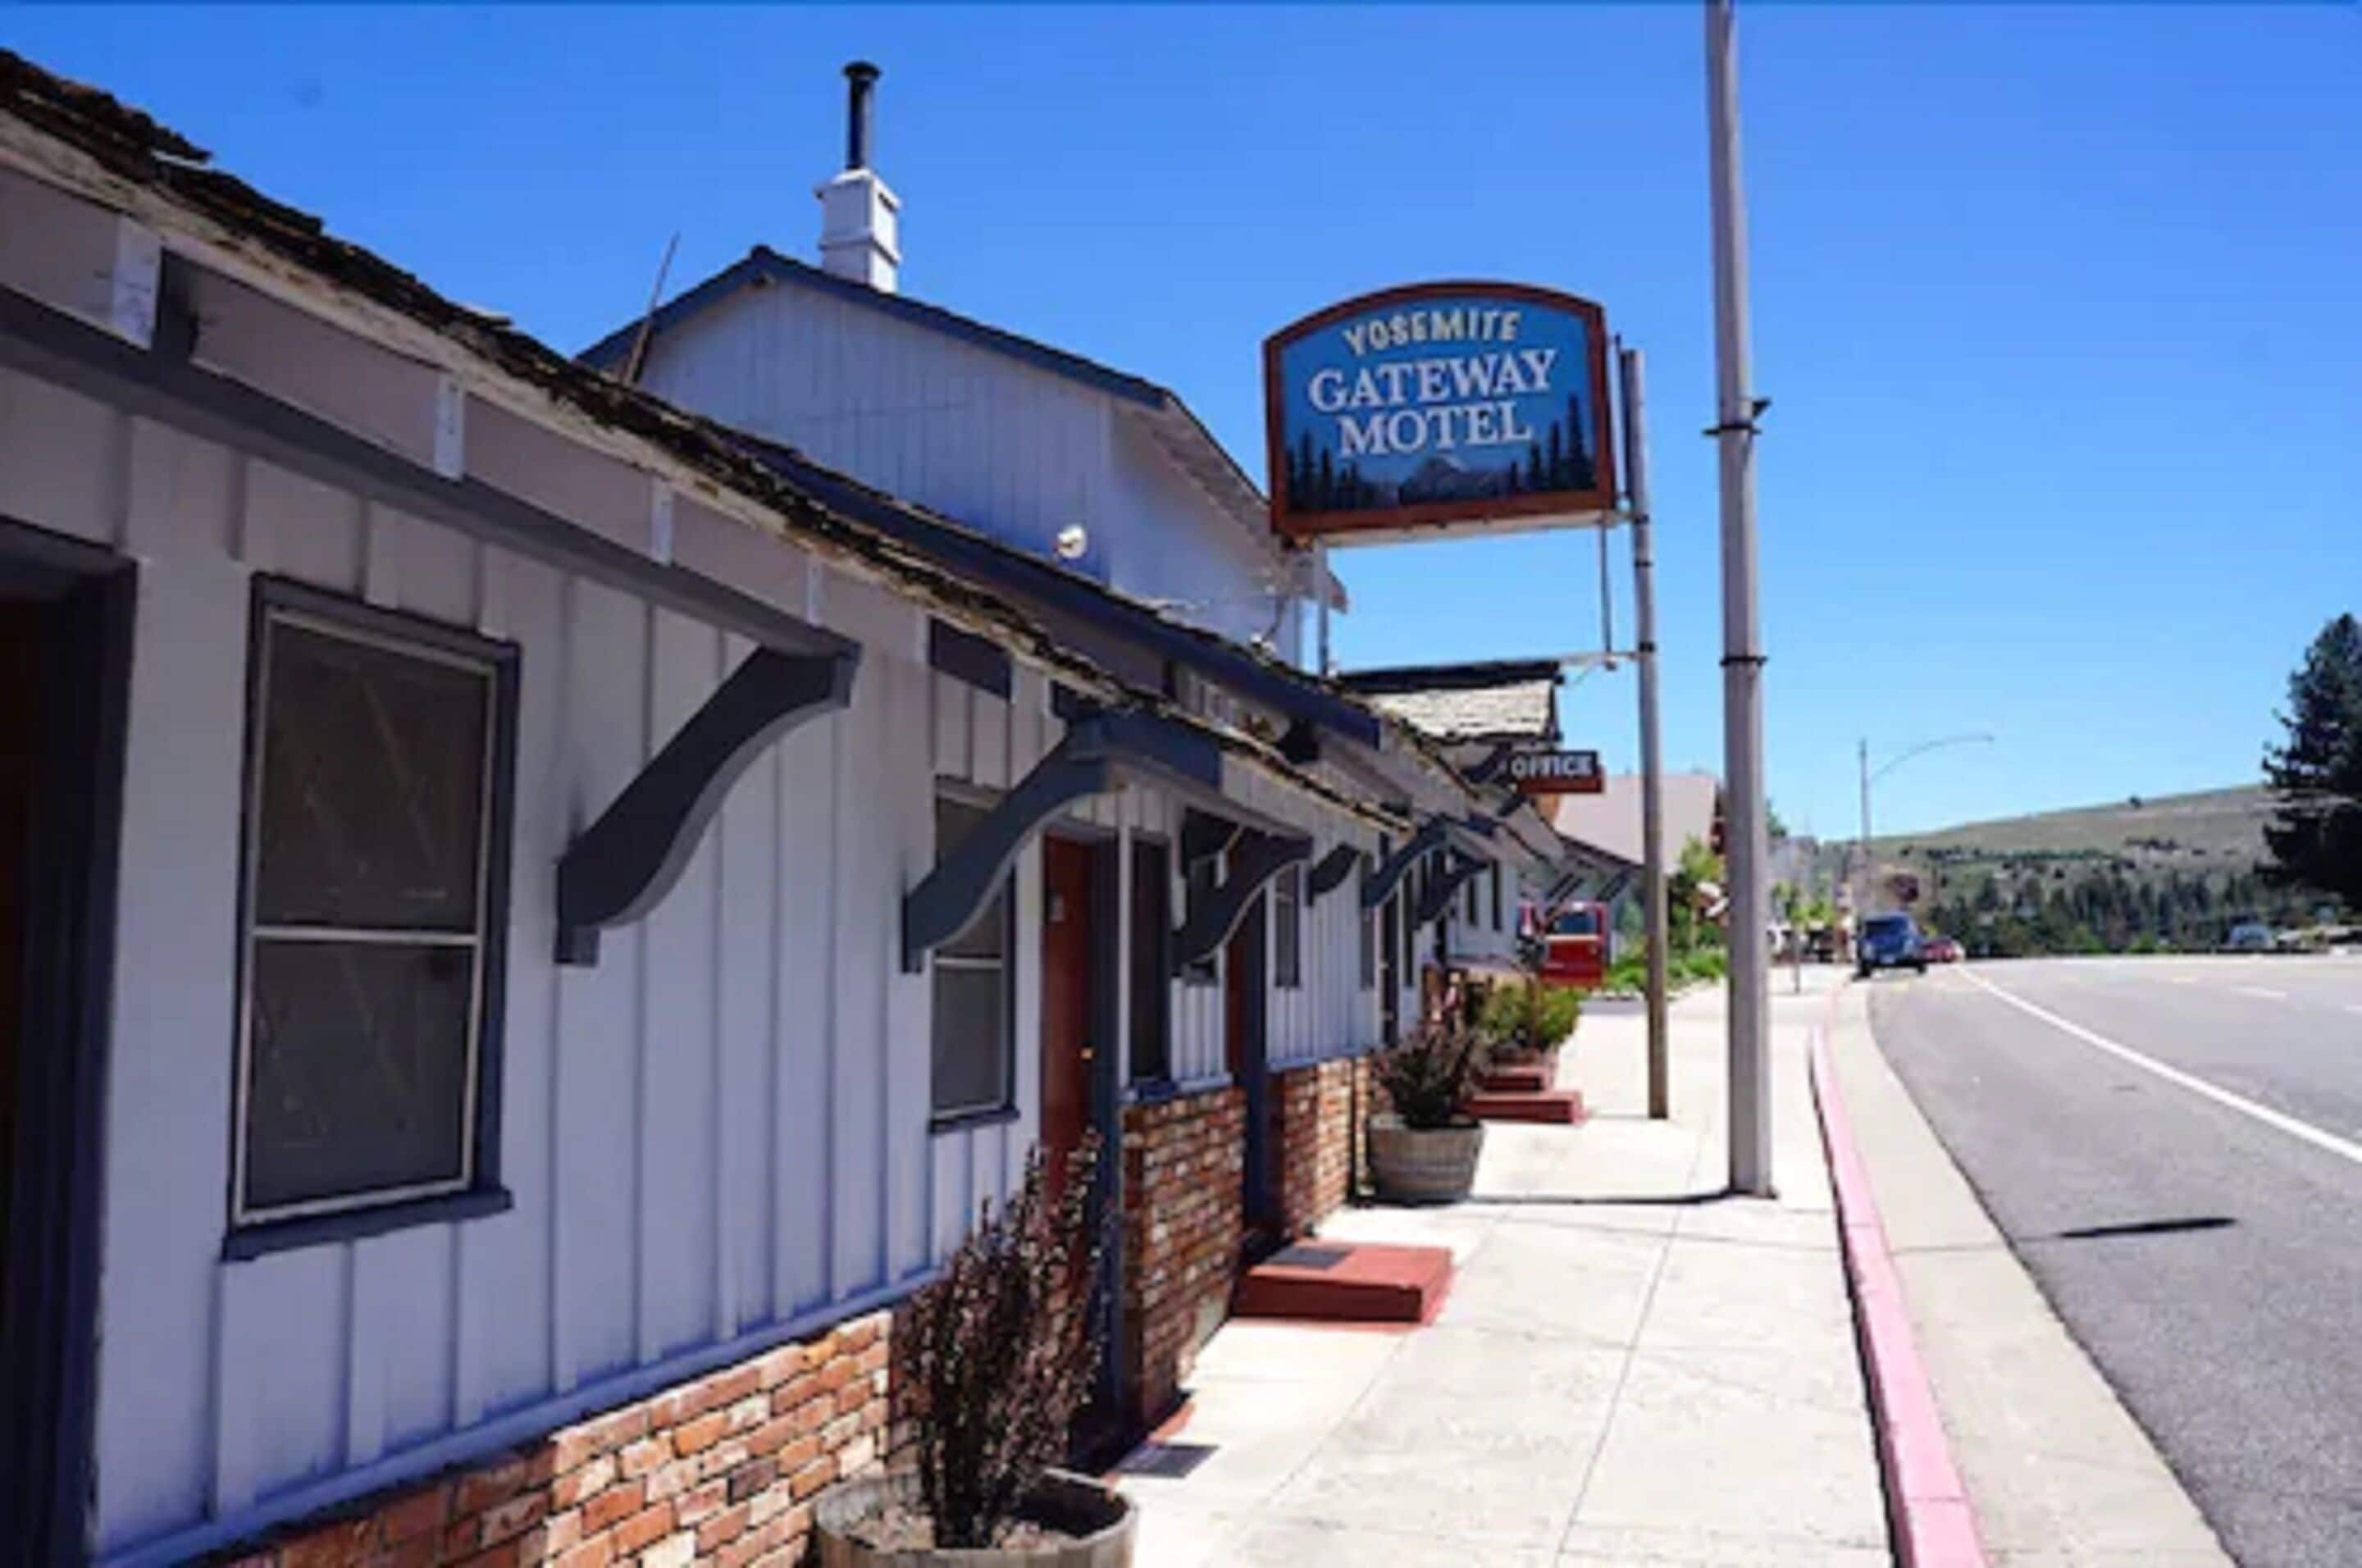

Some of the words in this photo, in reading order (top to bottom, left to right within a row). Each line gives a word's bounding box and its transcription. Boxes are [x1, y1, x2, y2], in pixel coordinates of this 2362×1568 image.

[1344, 309, 1521, 355] YOSEMITE
[1309, 349, 1557, 412] GATEWAY
[1338, 401, 1532, 456] MOTEL
[1510, 754, 1594, 777] OFFICE
